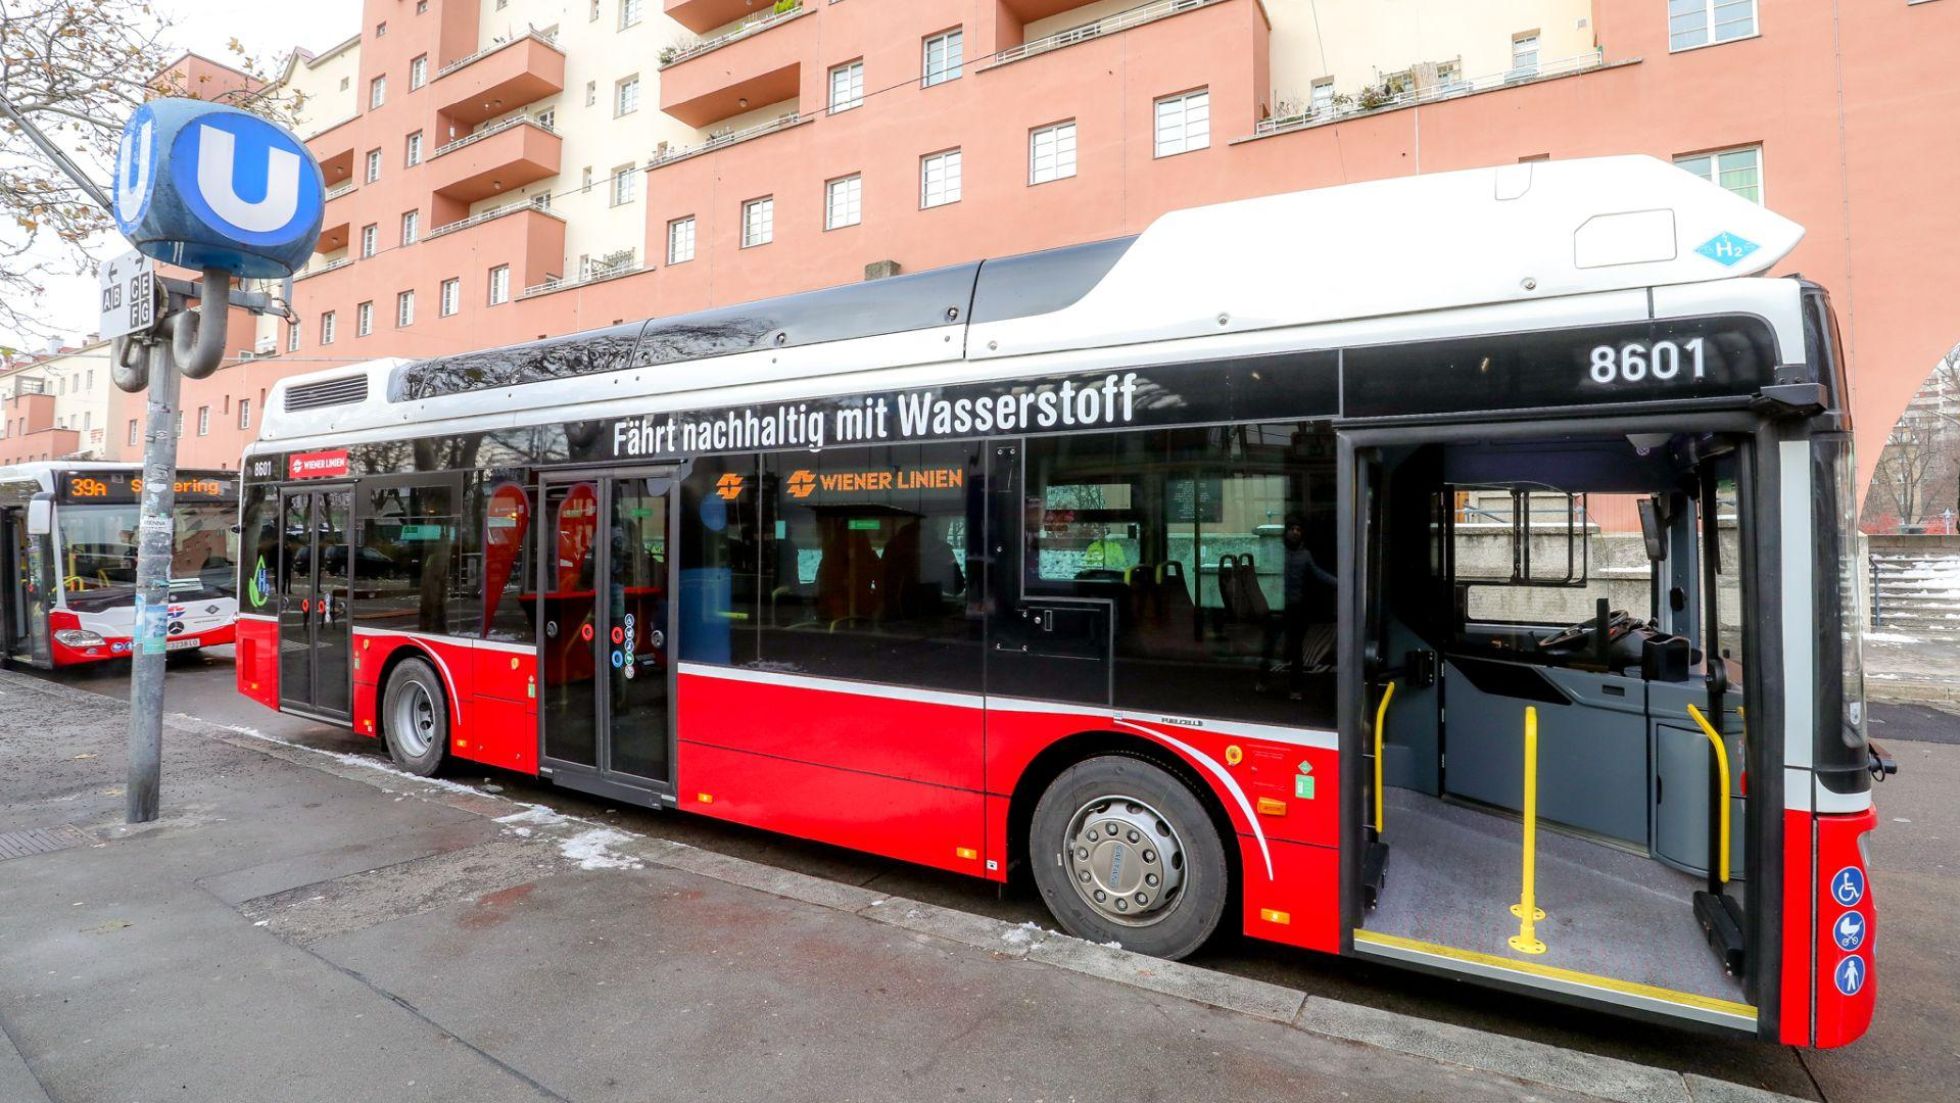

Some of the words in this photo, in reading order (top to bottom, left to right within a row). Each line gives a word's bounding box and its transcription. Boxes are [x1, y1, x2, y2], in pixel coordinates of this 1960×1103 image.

[118, 120, 153, 222] U
[197, 124, 300, 233] U
[1589, 337, 1706, 383] 8601
[613, 418, 676, 457] Fährt
[682, 405, 825, 454] nachhaltig
[836, 397, 889, 442] mit
[897, 372, 1137, 438] Wasserstoff
[254, 460, 272, 476] 8601
[303, 458, 325, 470] WIENER
[325, 456, 345, 468] LINIEN
[820, 471, 892, 491] WIENER
[897, 468, 963, 489] LINIEN
[71, 478, 107, 497] 39A
[131, 478, 221, 496] Sering
